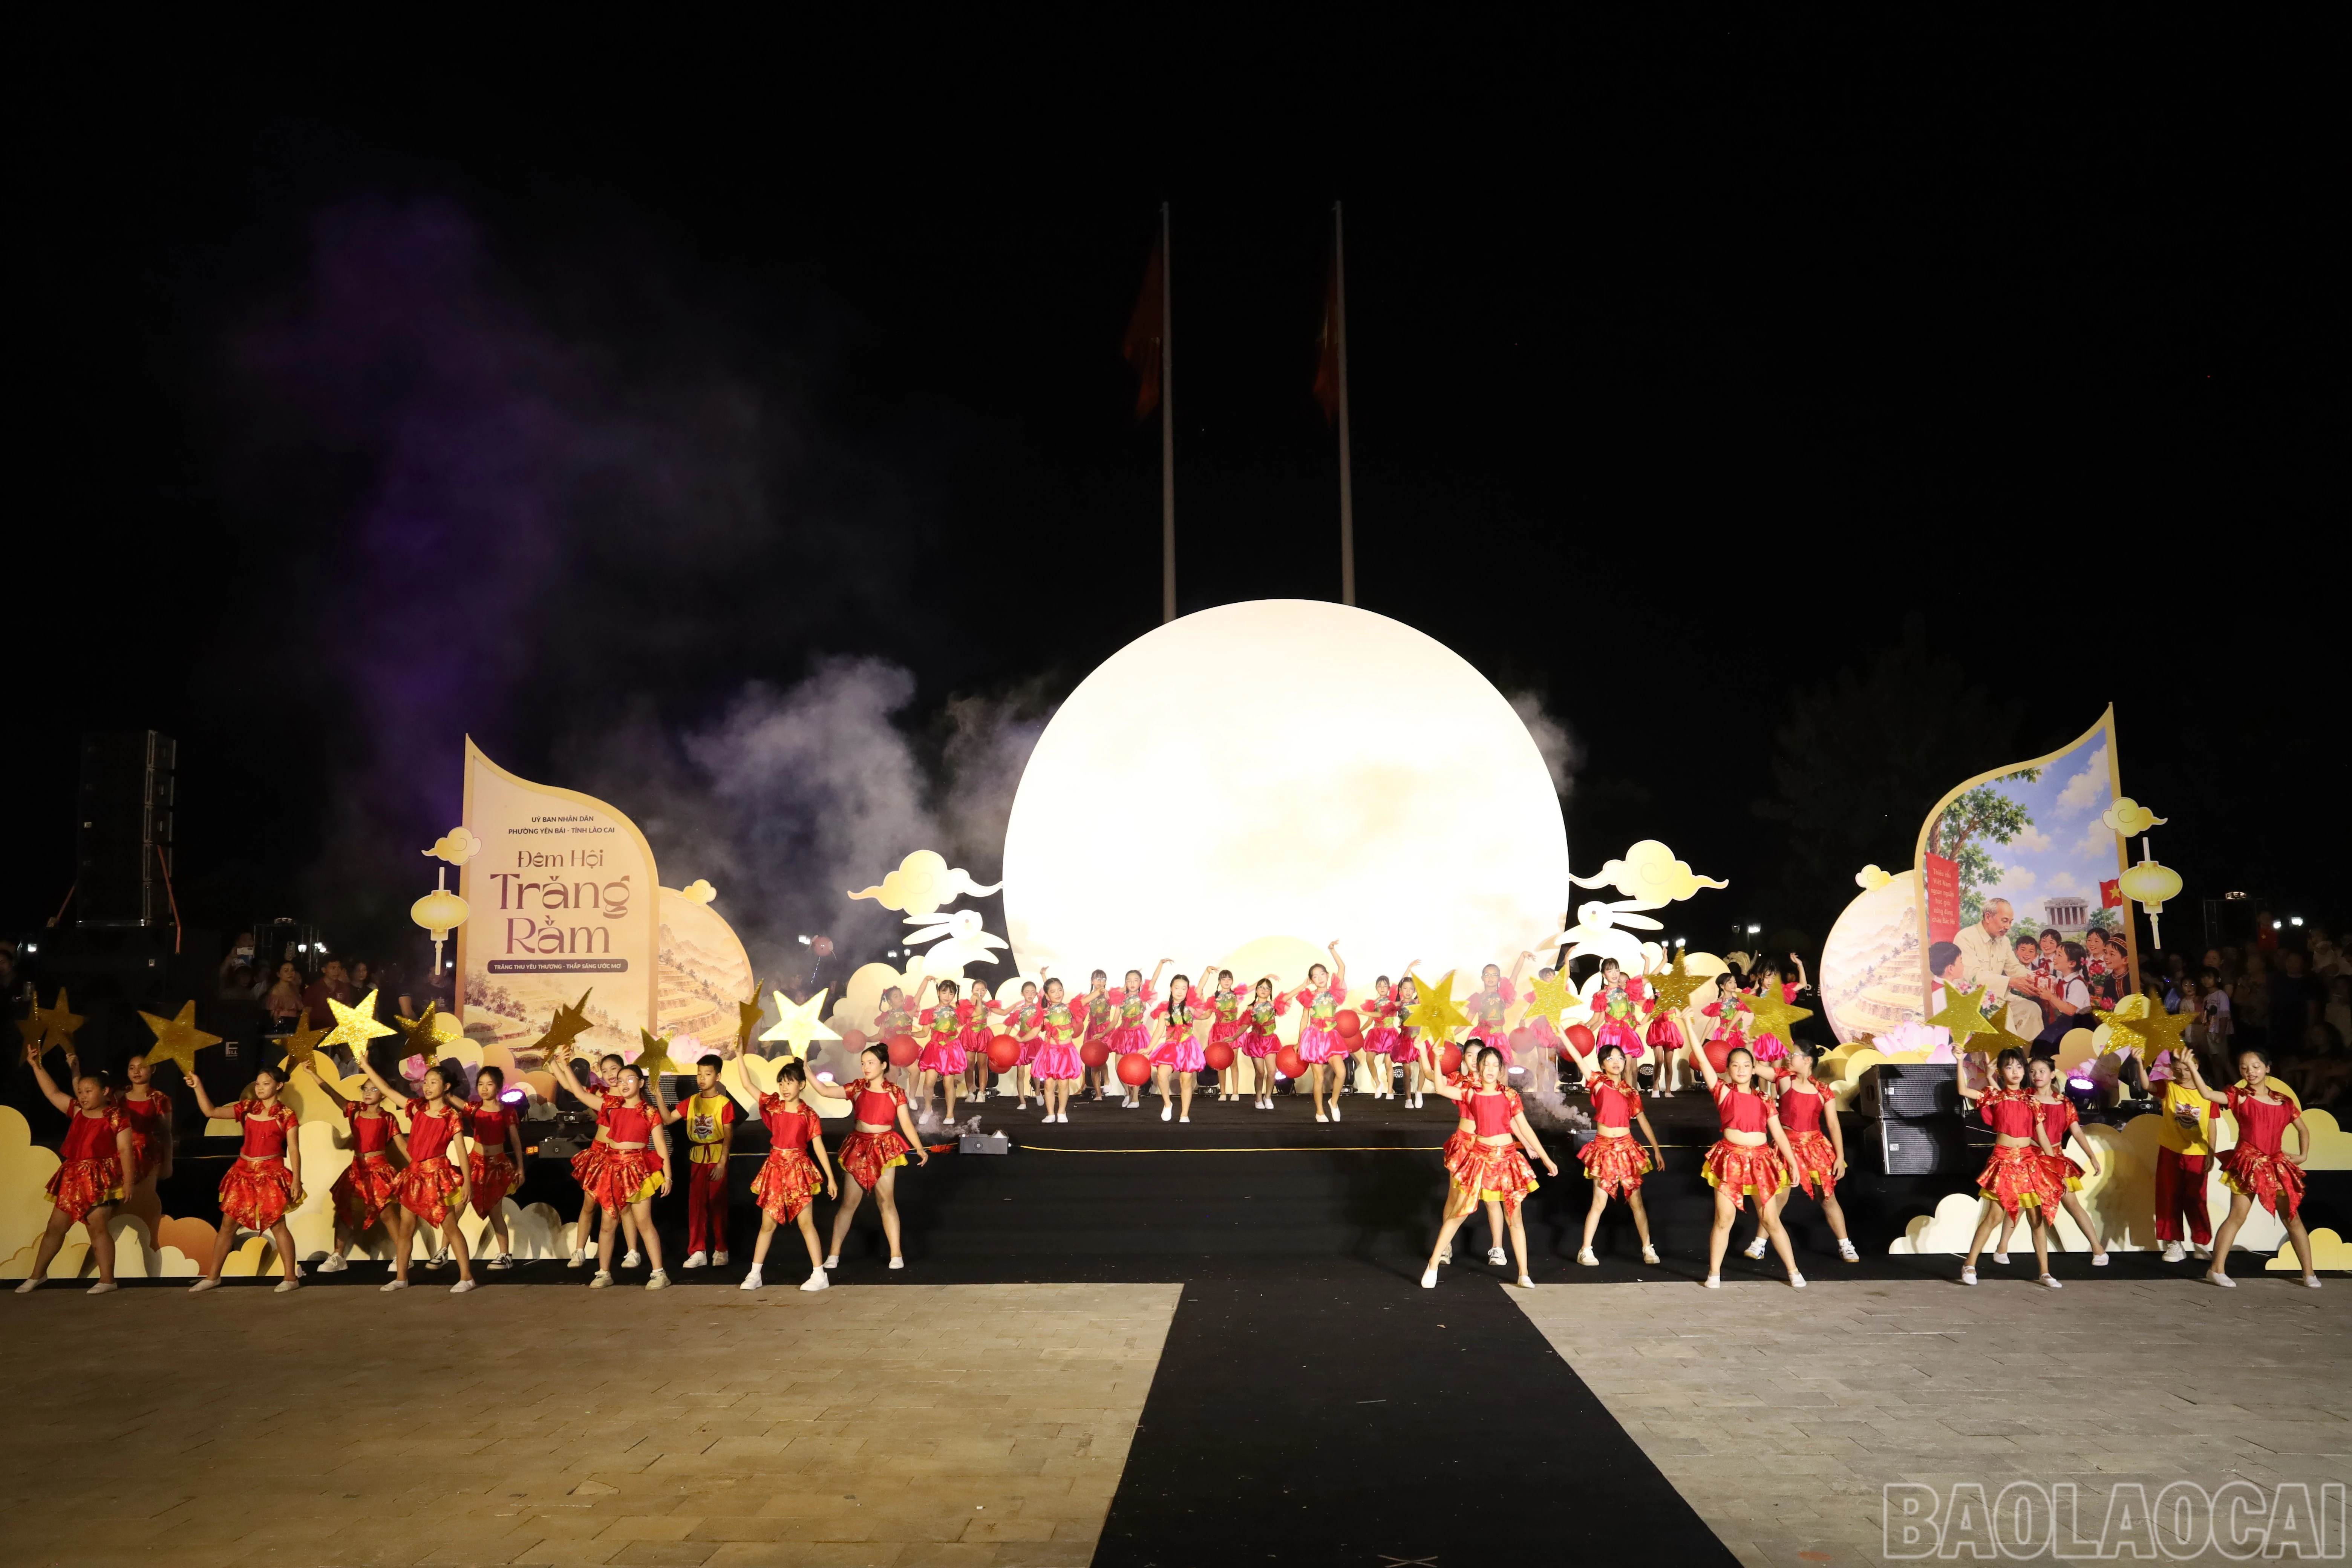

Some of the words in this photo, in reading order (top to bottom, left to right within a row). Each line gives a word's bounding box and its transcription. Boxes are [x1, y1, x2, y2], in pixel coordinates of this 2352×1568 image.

[518, 850, 564, 868] Đêm
[570, 849, 603, 869] Hội
[490, 873, 630, 919] Trăng
[505, 915, 611, 954] Rằm
